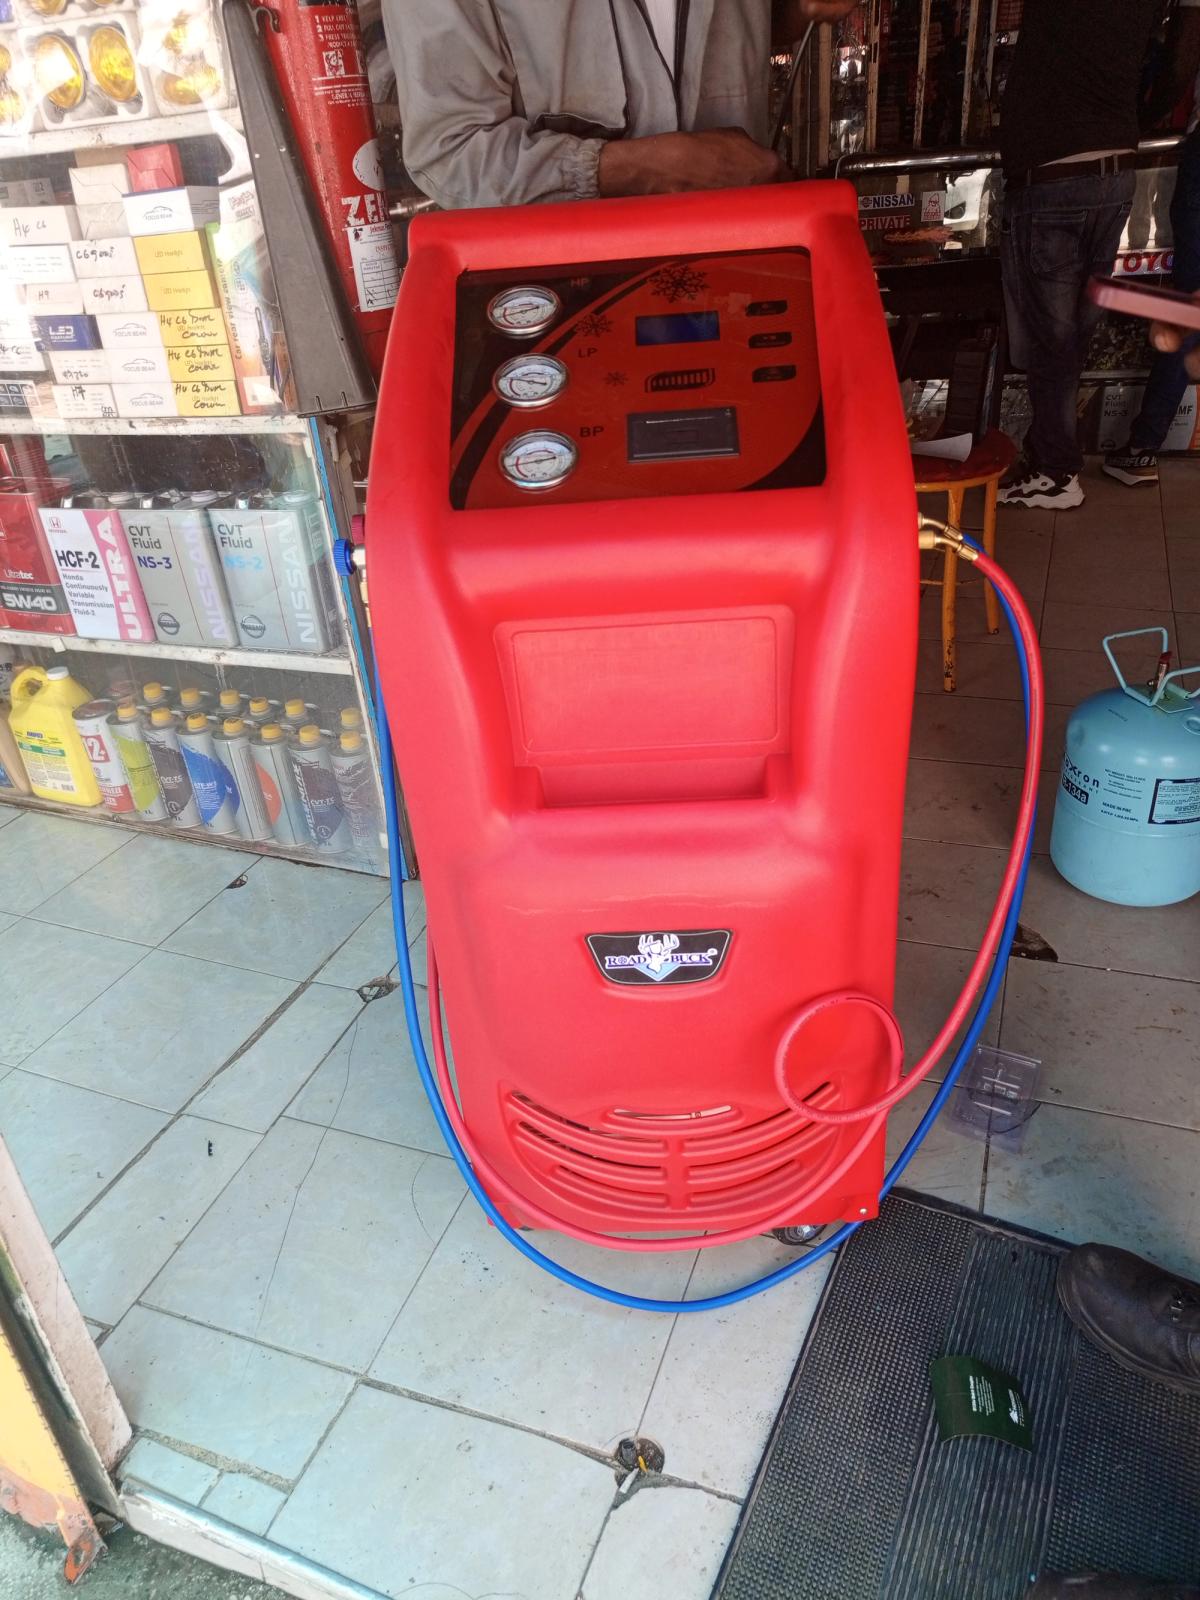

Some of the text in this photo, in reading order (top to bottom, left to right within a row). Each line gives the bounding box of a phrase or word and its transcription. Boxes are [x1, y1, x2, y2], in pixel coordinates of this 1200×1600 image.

[316, 24, 323, 33] 2
[872, 194, 914, 208] NISSAN
[860, 215, 911, 231] PRIVATE
[570, 278, 589, 287] HP
[49, 326, 74, 335] LED
[578, 347, 598, 357] LP
[579, 426, 604, 437] BP
[128, 525, 151, 537] CVT
[217, 523, 243, 536] CVT
[132, 537, 161, 550] Fluid
[220, 536, 254, 550] Fluid
[55, 549, 101, 569] HCF-2
[137, 555, 173, 570] NS-3
[224, 554, 264, 571] NS-2
[62, 573, 84, 581] Honda
[96, 516, 143, 640] ULTRA
[277, 516, 318, 644] NISSAN
[65, 582, 109, 592] Continuously
[68, 591, 95, 599] Variable
[71, 599, 115, 609] Transmission
[607, 952, 710, 966] ROAD BUCK
